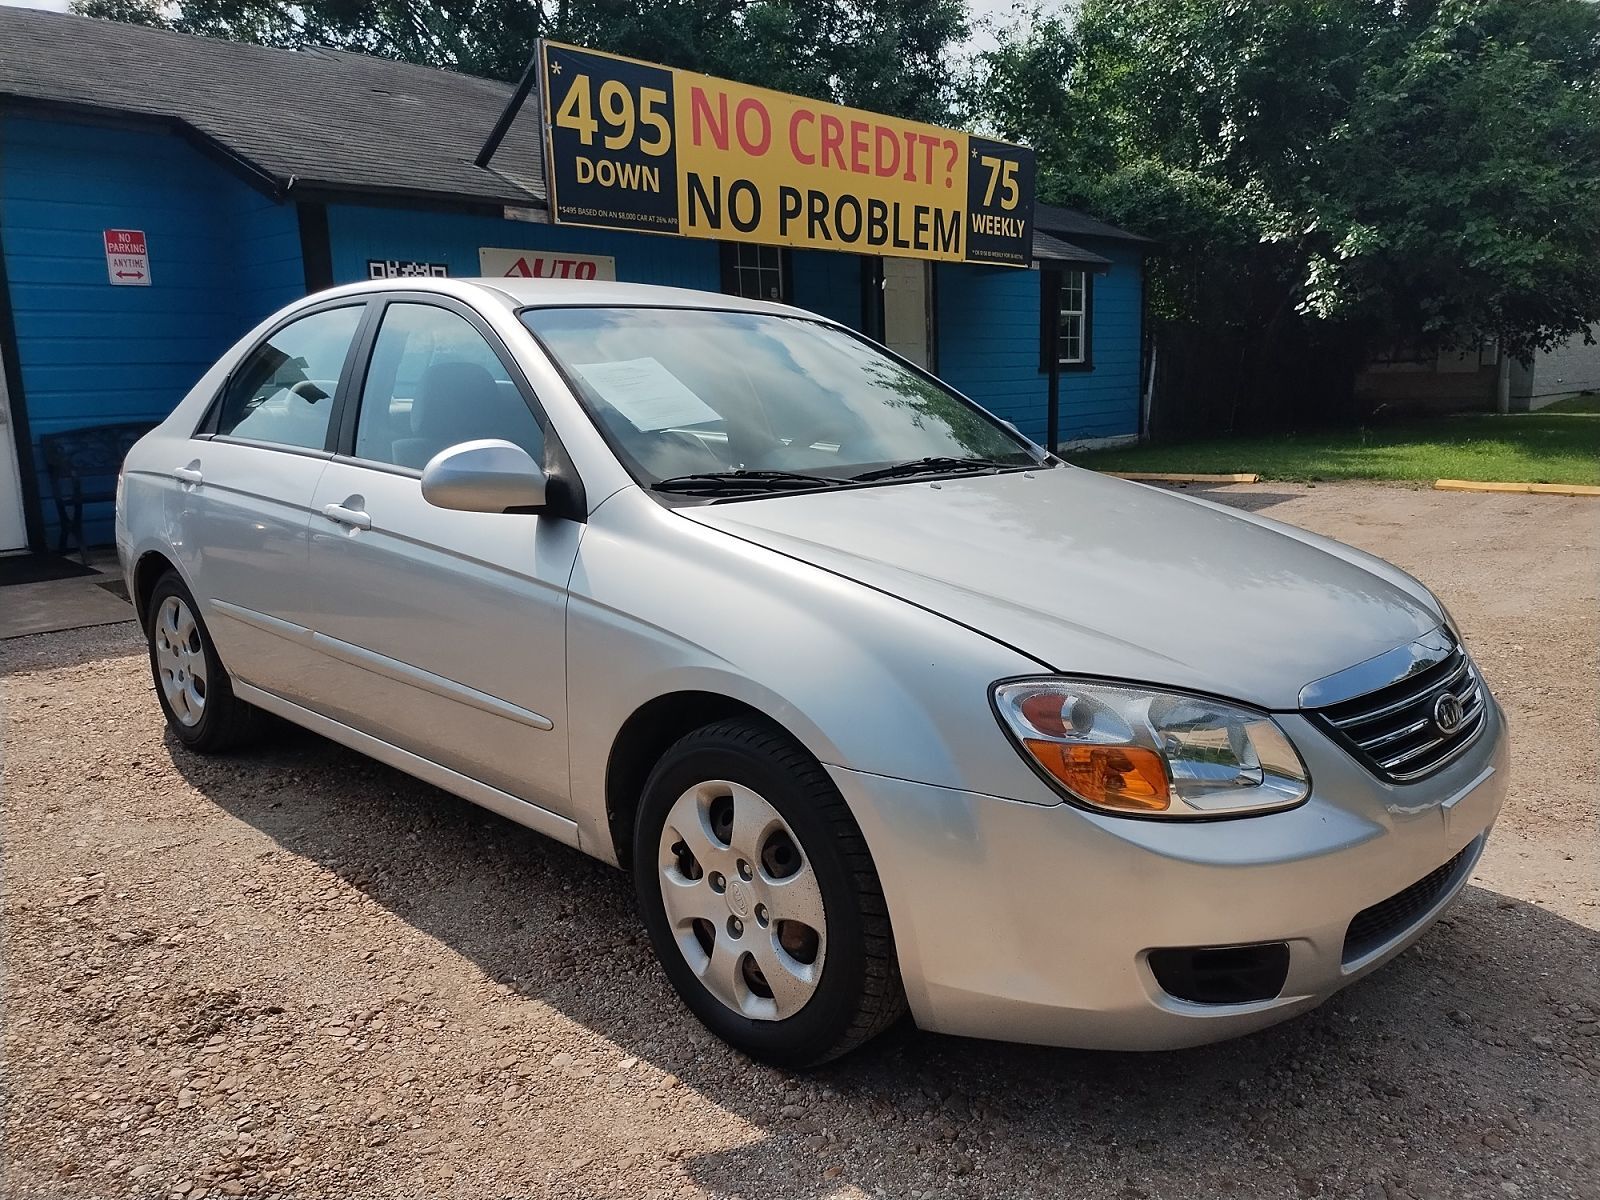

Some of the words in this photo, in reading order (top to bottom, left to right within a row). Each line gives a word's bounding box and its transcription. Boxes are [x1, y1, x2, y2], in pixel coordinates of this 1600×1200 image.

[691, 86, 771, 157] NO
[789, 109, 959, 189] CREDIT?
[575, 156, 660, 193] DOWN
[578, 207, 597, 216] BASED
[598, 209, 608, 217] ON
[609, 211, 618, 219] AN
[637, 213, 648, 222] CAR
[687, 172, 761, 233] NO
[779, 185, 961, 253] PROBLEM
[972, 213, 1025, 238] WEEKLY
[108, 243, 145, 253] PARKING
[119, 233, 131, 243] NO
[114, 258, 144, 268] ANYTIME
[504, 257, 597, 280] AUTO
